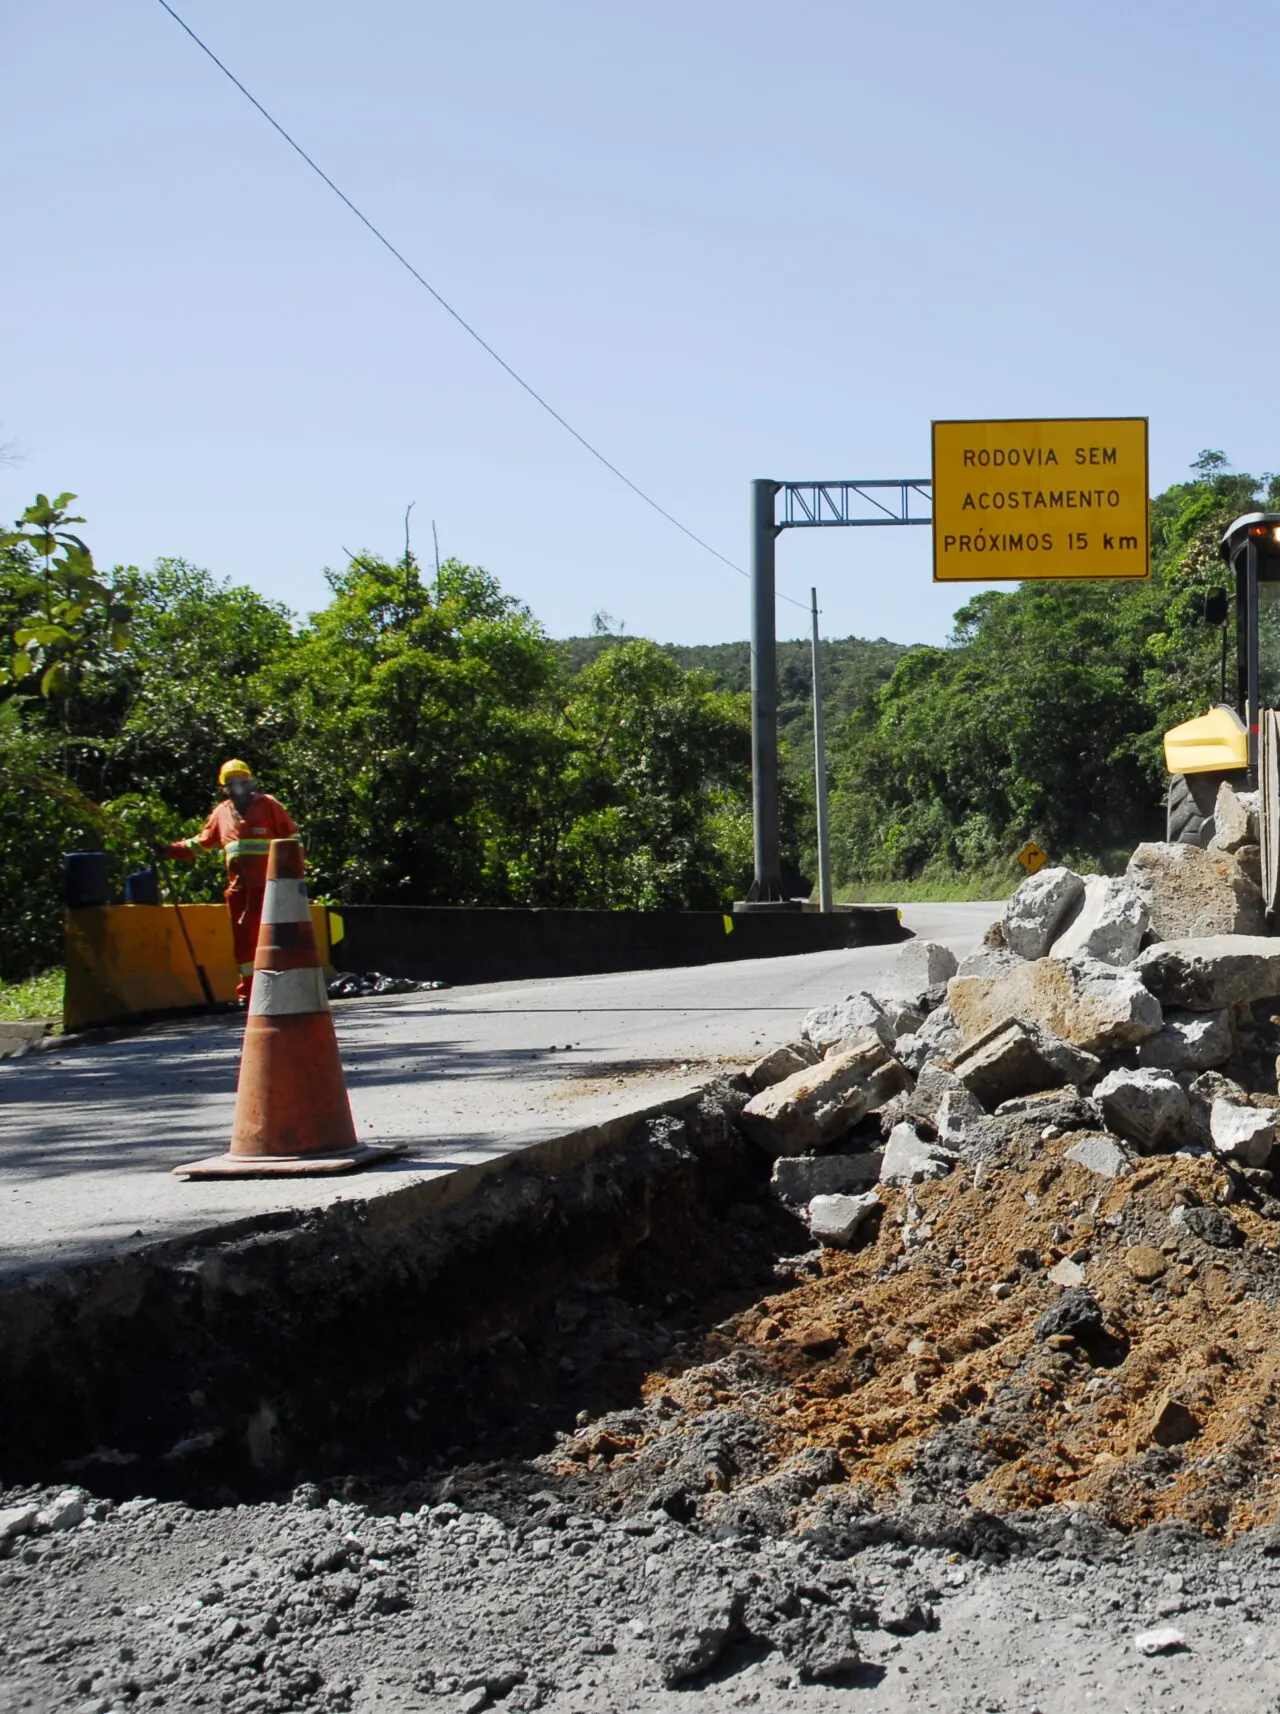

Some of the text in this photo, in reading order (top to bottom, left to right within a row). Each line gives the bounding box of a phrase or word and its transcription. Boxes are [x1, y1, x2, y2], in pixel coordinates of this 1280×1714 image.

[963, 447, 1117, 467] RODOVIA SEM
[962, 490, 1120, 511] ACOSTAMENTO
[943, 527, 1138, 553] PRÓXIMOS 15 km
